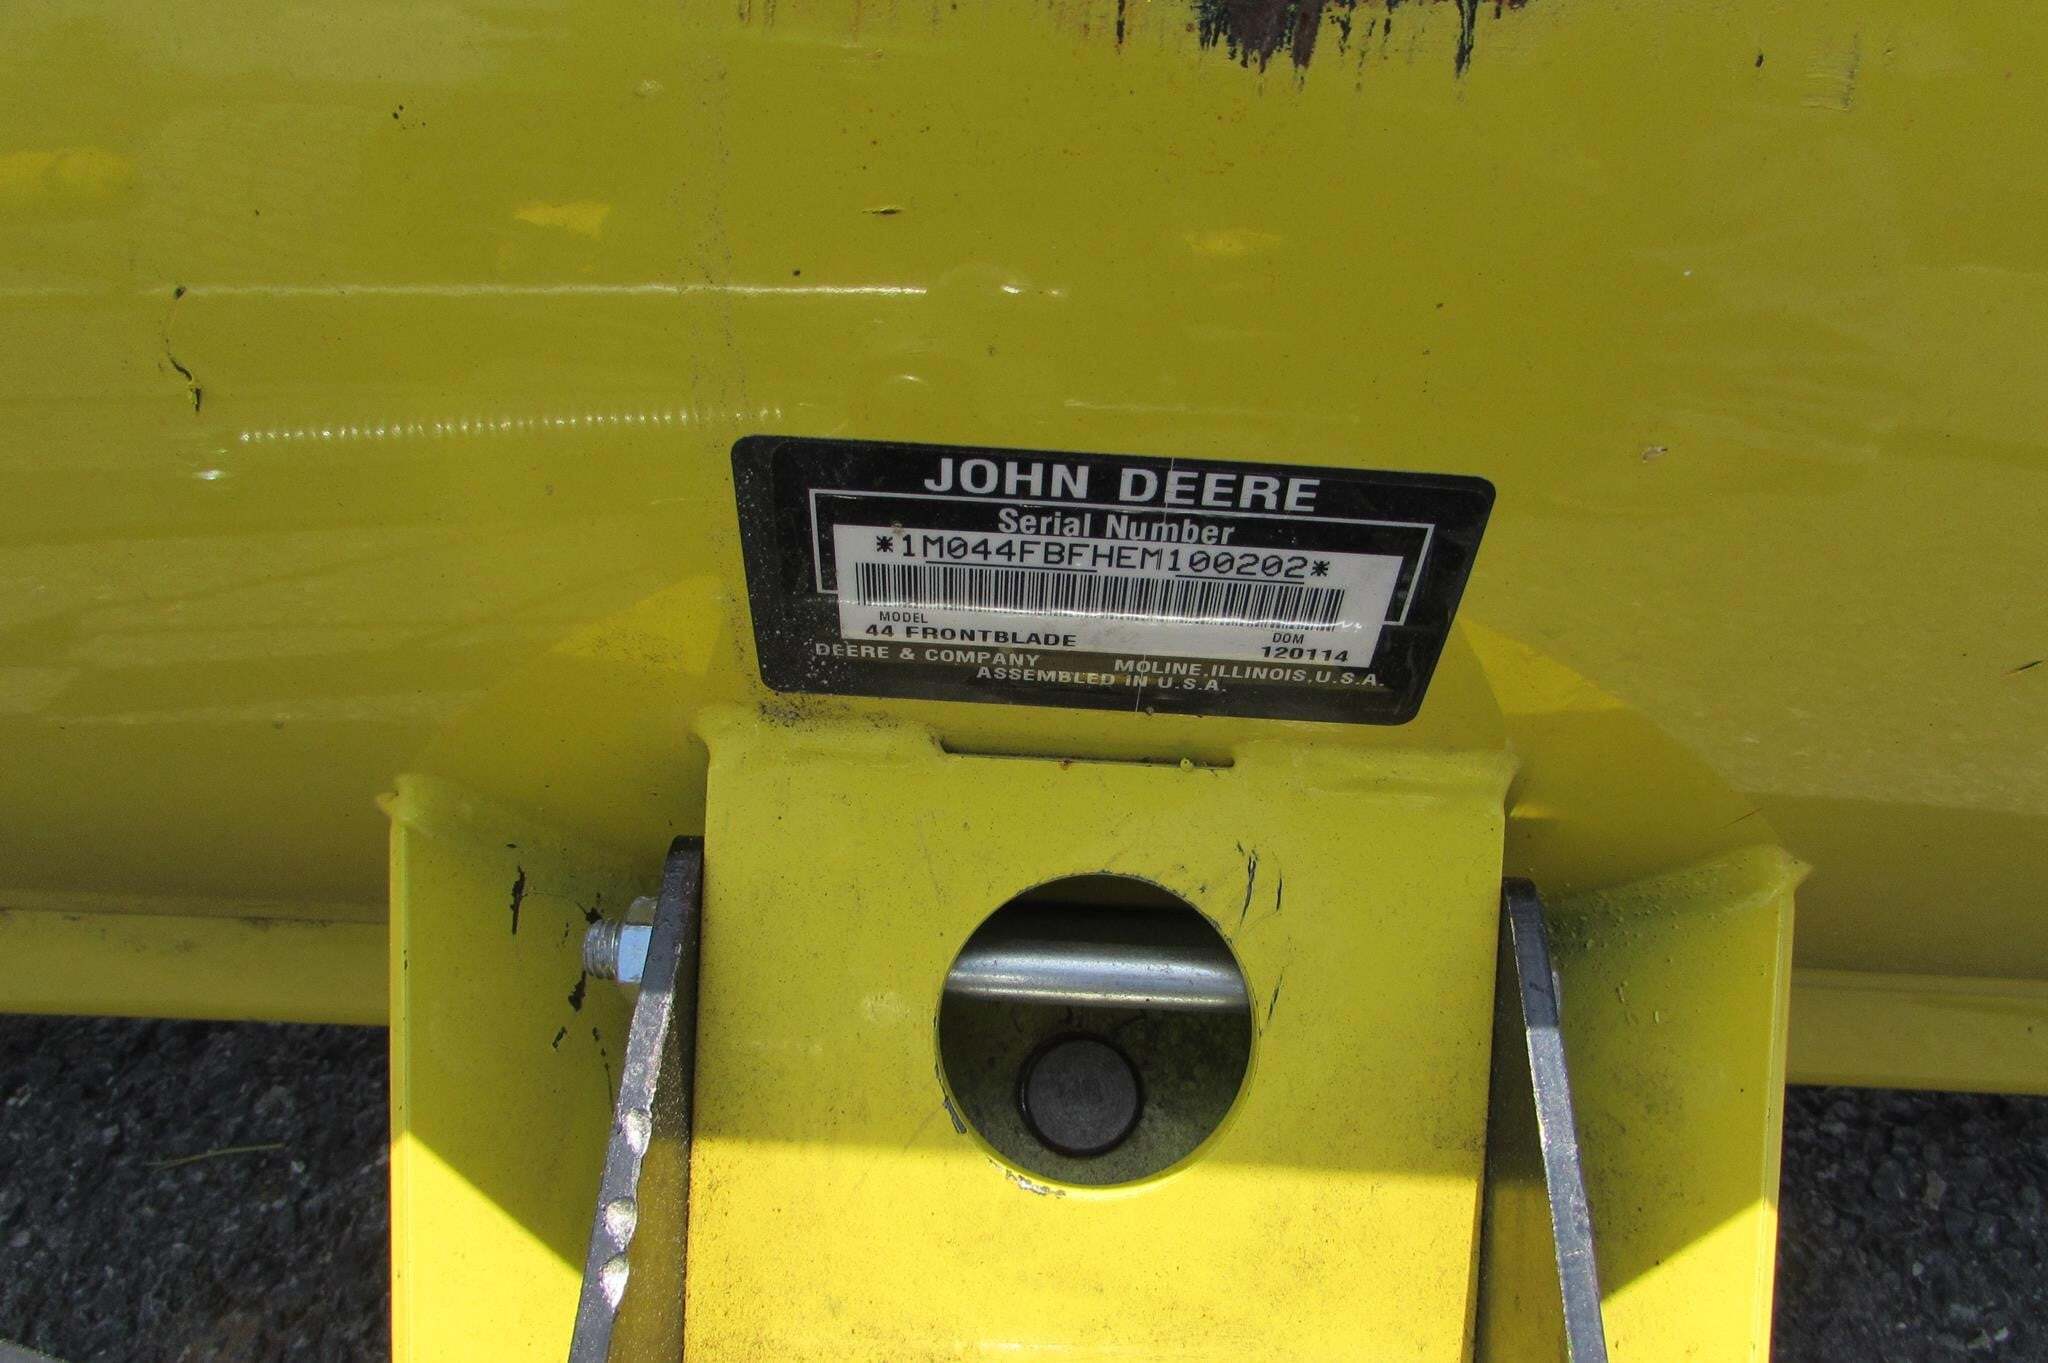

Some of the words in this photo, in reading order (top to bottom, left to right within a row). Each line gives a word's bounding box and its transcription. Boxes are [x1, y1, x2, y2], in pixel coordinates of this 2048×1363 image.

[924, 458, 1088, 499] JOHN
[1118, 467, 1320, 512] DEERE
[998, 508, 1093, 537] Serial
[1105, 514, 1235, 545] Number
[879, 611, 928, 624] MODEL
[866, 624, 895, 637] 44
[905, 625, 1077, 647] FRONTBLADE
[1272, 632, 1304, 644] DOM
[815, 643, 888, 659] DEERE
[899, 647, 915, 660] &
[925, 649, 1040, 667] COMPANY
[1261, 646, 1349, 663] 120114
[976, 666, 1116, 687] ASSEMBLED
[1124, 674, 1149, 688] IN
[1158, 675, 1227, 692] U.S.A.
